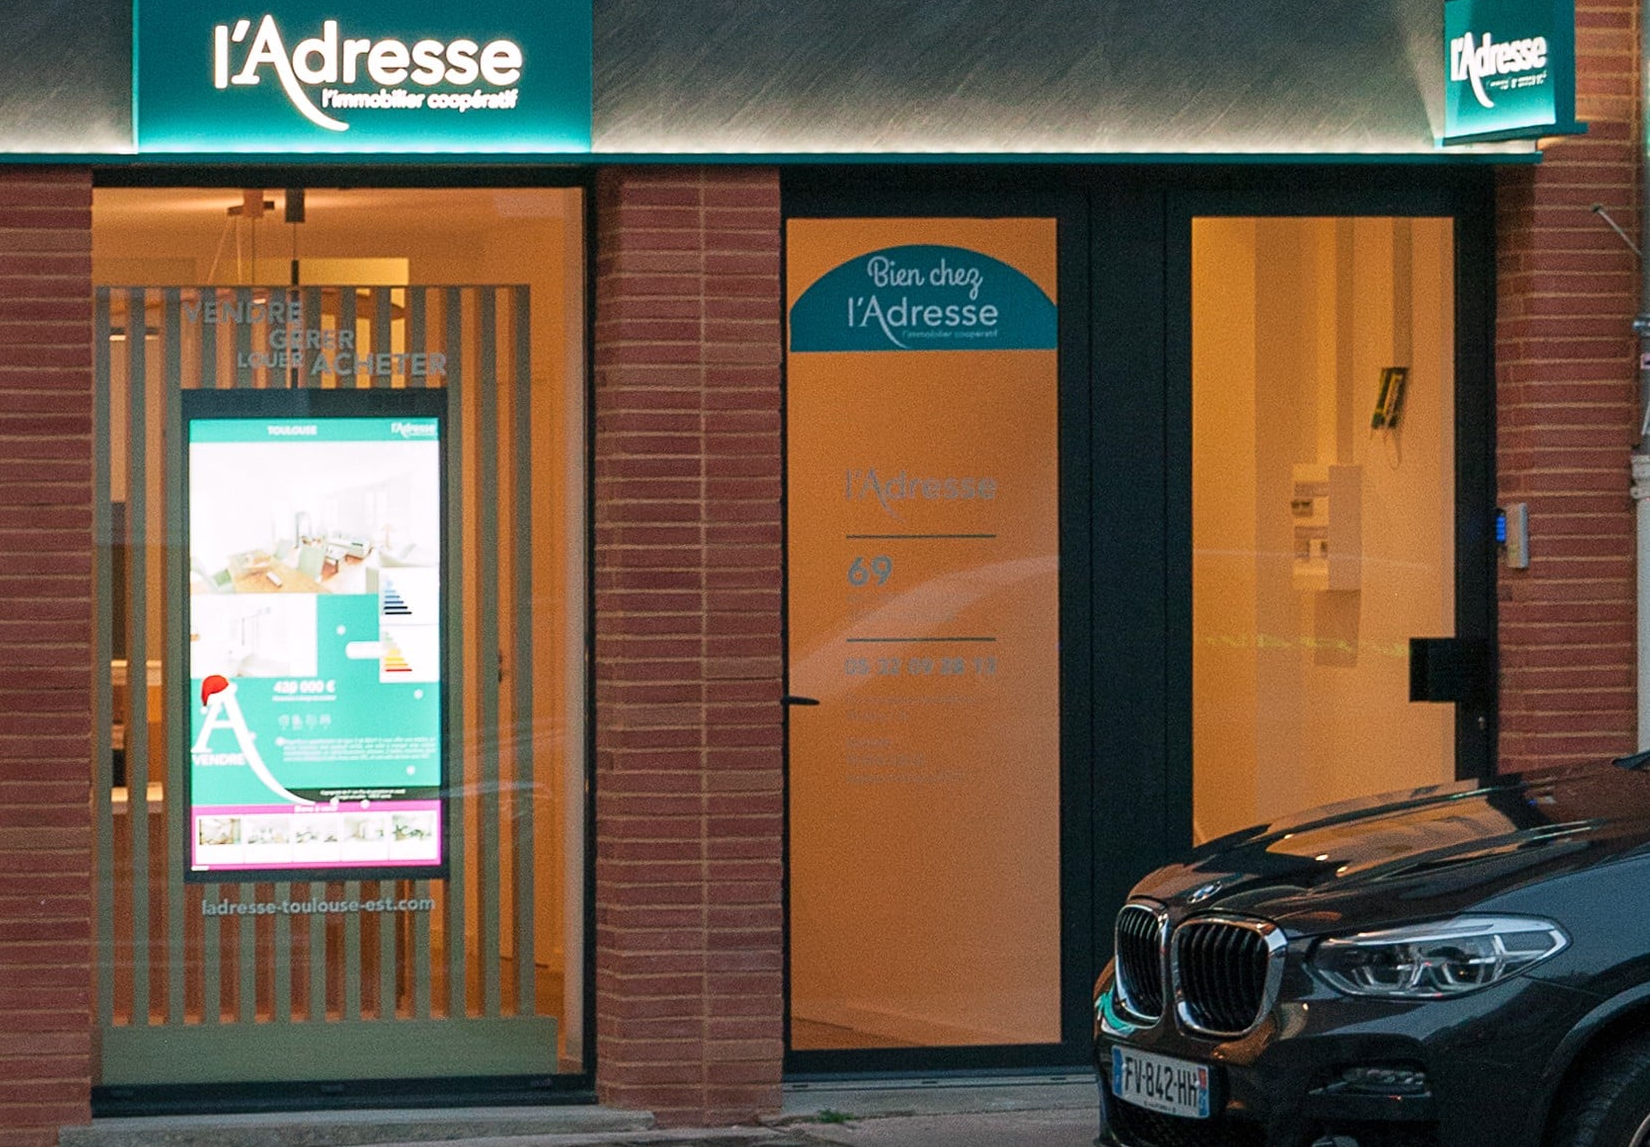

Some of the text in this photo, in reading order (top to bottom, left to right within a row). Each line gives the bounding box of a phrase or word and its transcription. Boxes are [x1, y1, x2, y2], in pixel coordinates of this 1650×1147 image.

[214, 13, 523, 131] l'Adresse
[1450, 31, 1547, 108] l'Adresse
[322, 88, 425, 108] l'immobilier
[867, 256, 983, 301] Bien chez
[183, 302, 301, 323] VENDRE
[848, 295, 999, 349] l'Adresse
[238, 351, 303, 368] LOUER
[311, 352, 447, 375] ACHETER
[846, 467, 997, 523] l'Adresse
[847, 556, 893, 586] 69
